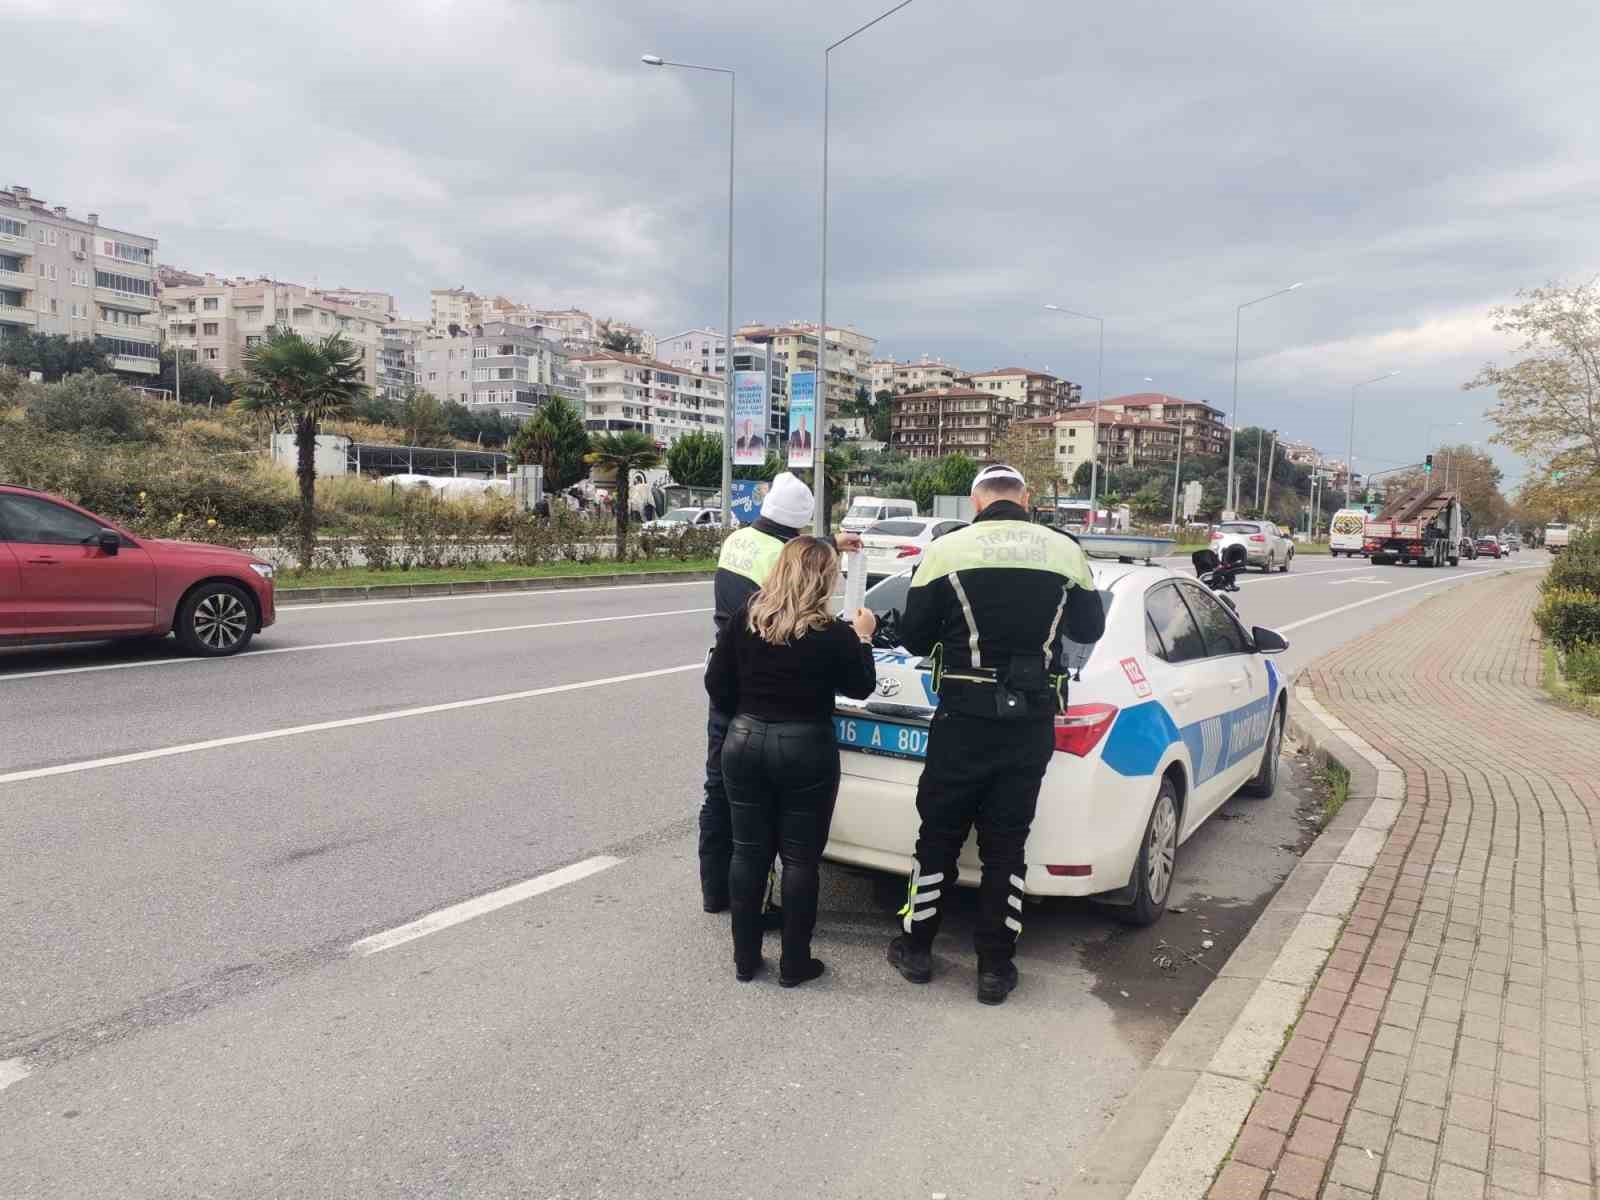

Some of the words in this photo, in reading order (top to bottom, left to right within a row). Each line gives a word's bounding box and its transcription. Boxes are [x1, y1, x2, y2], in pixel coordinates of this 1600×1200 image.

[840, 720, 857, 742] 16
[871, 724, 881, 747] A
[898, 728, 929, 753] 807
